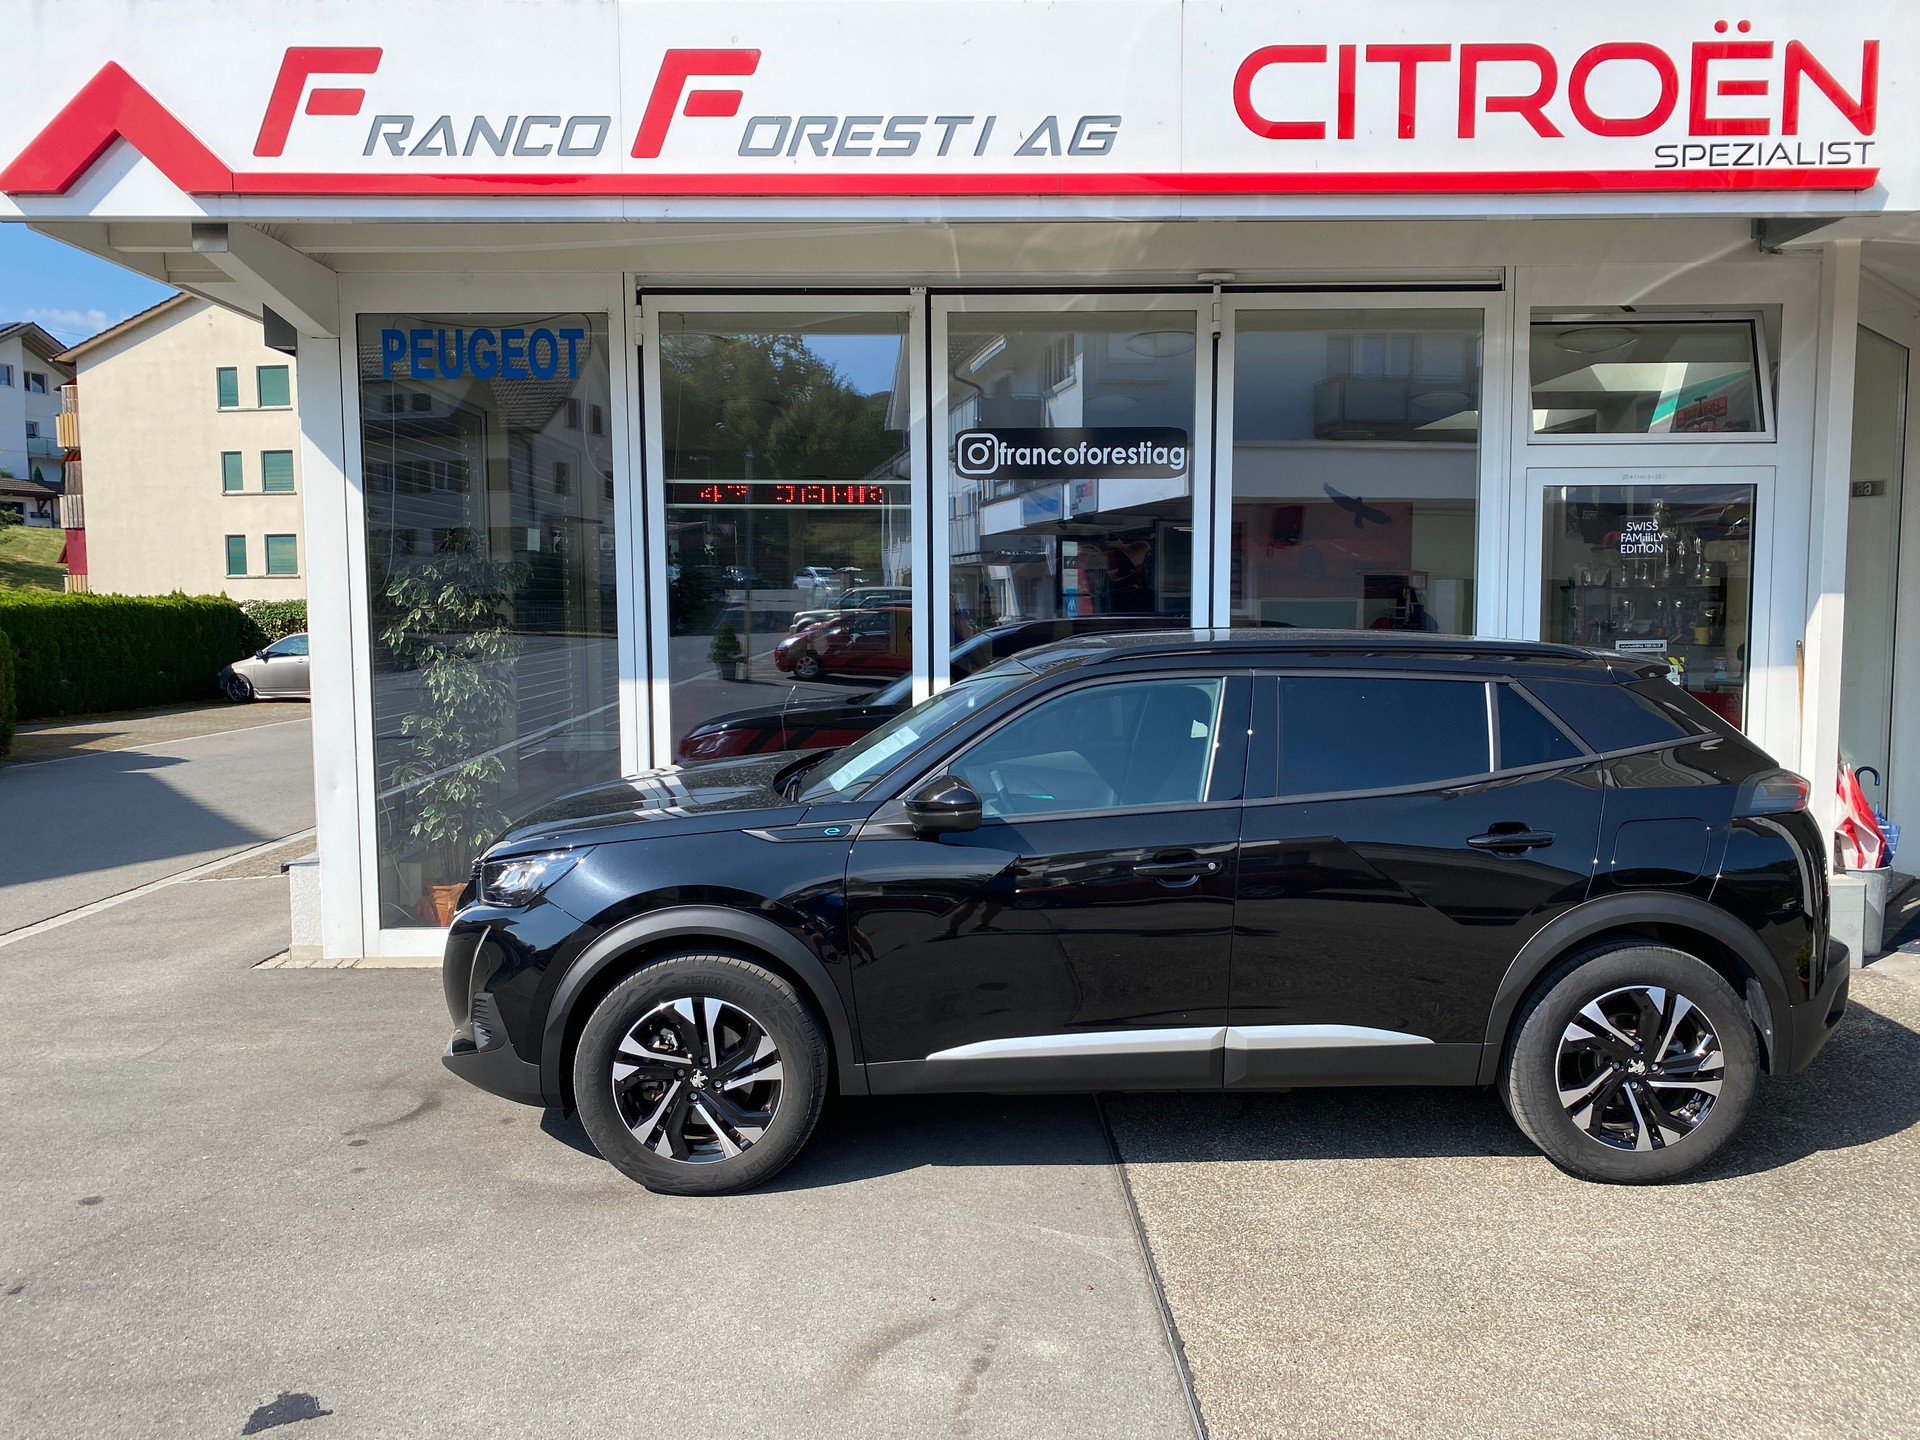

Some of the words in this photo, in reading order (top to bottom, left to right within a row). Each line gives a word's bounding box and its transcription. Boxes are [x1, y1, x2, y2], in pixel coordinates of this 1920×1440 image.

[1232, 19, 1880, 140] CITROËN
[252, 46, 612, 158] FRANCO
[630, 48, 997, 159] FORESTI
[1013, 114, 1122, 158] AG
[1654, 141, 1876, 169] SPEZIALIST
[381, 327, 585, 380] PEUGEOT
[999, 440, 1185, 471] francoforestiag
[1626, 521, 1659, 532] SWISS
[1620, 543, 1664, 554] EDITION
